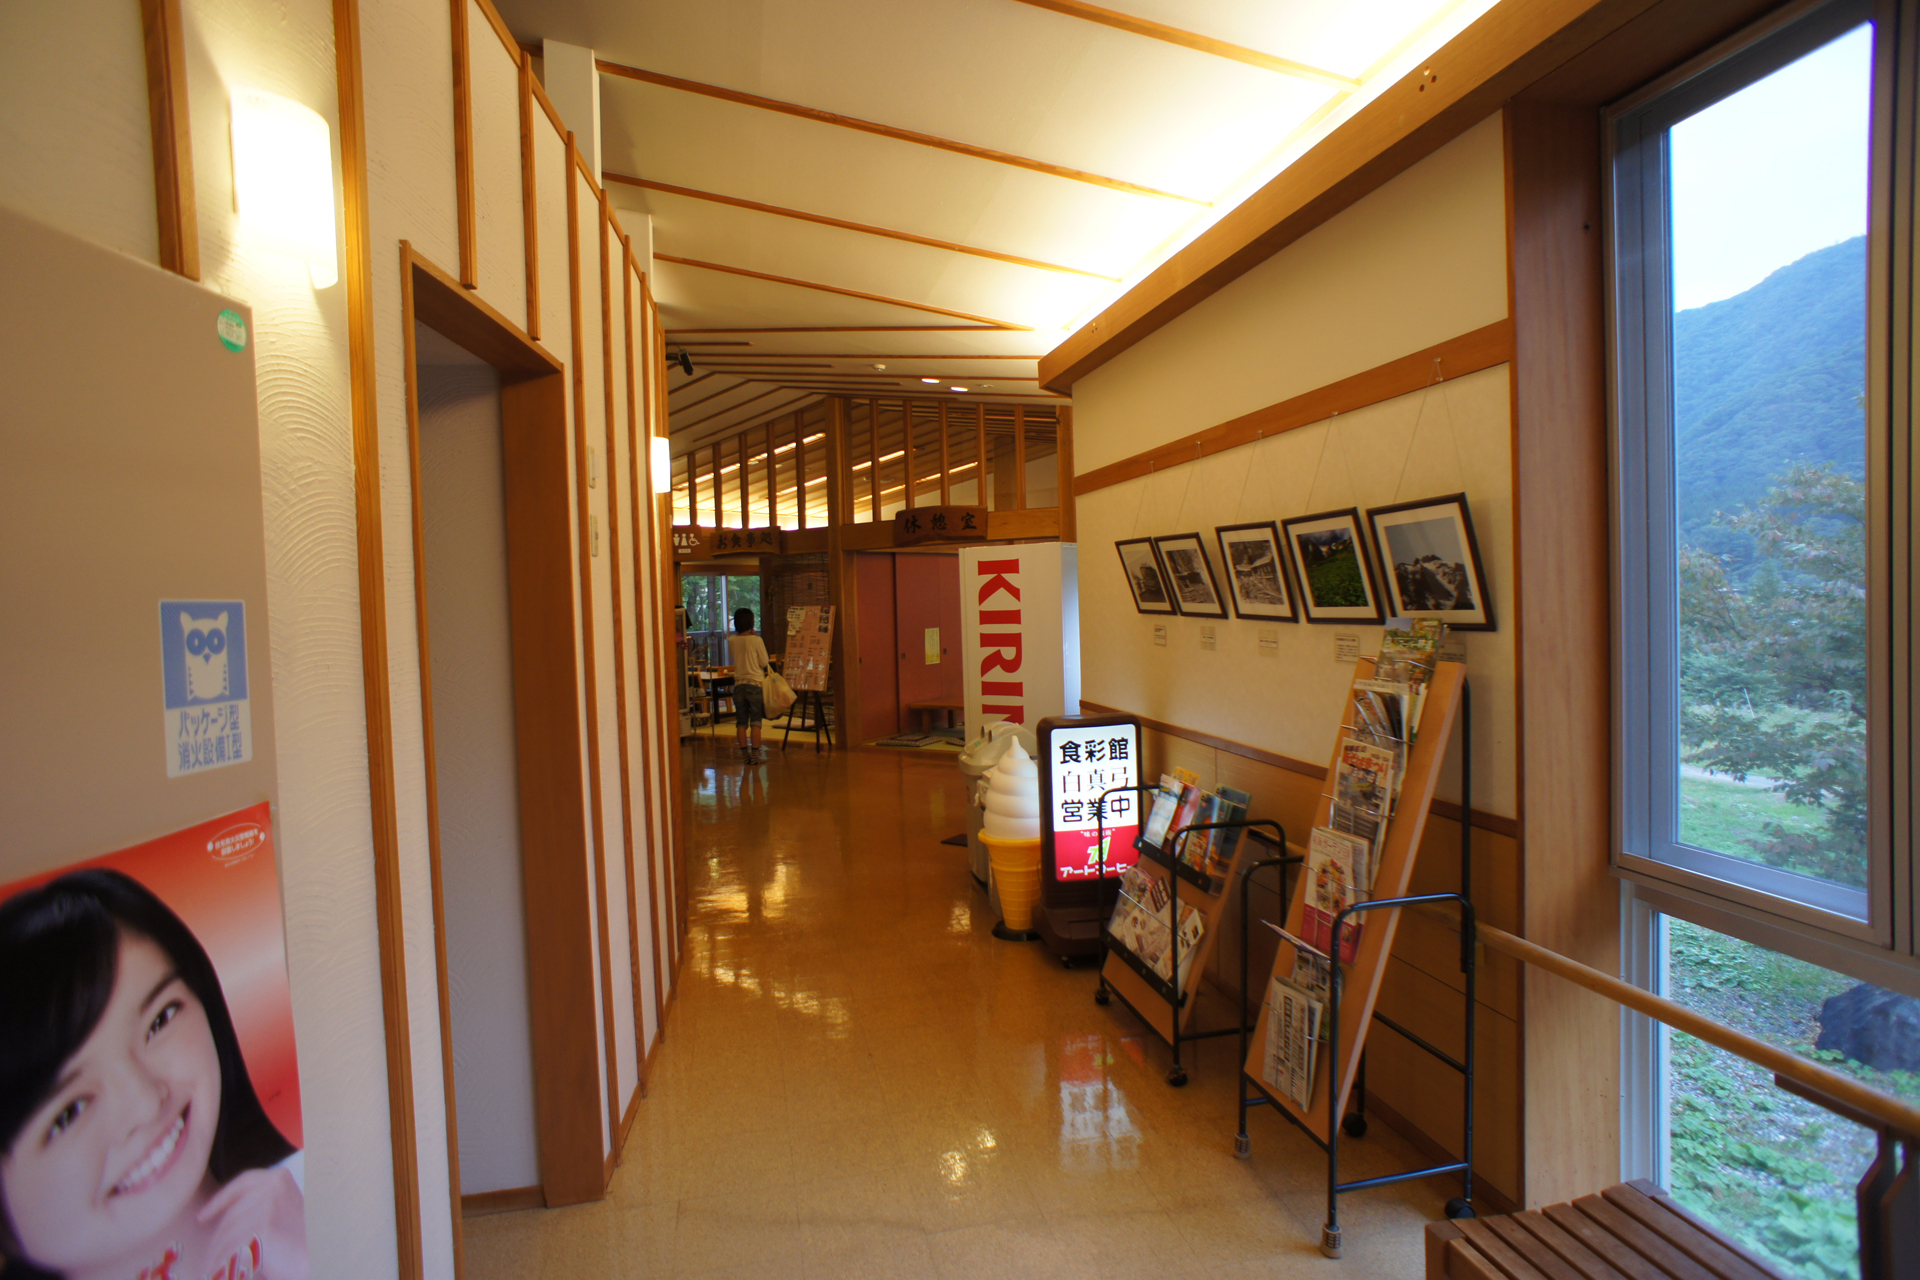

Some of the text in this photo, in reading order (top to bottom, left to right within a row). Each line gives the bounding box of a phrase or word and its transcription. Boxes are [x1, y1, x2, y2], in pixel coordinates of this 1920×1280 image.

[904, 512, 977, 534] 休憩室
[717, 531, 773, 549] お食事処
[179, 703, 240, 739] パッケージ型
[1059, 737, 1128, 764] 食彩館
[1063, 766, 1129, 793] 白真弓
[1061, 795, 1130, 822] 営業中
